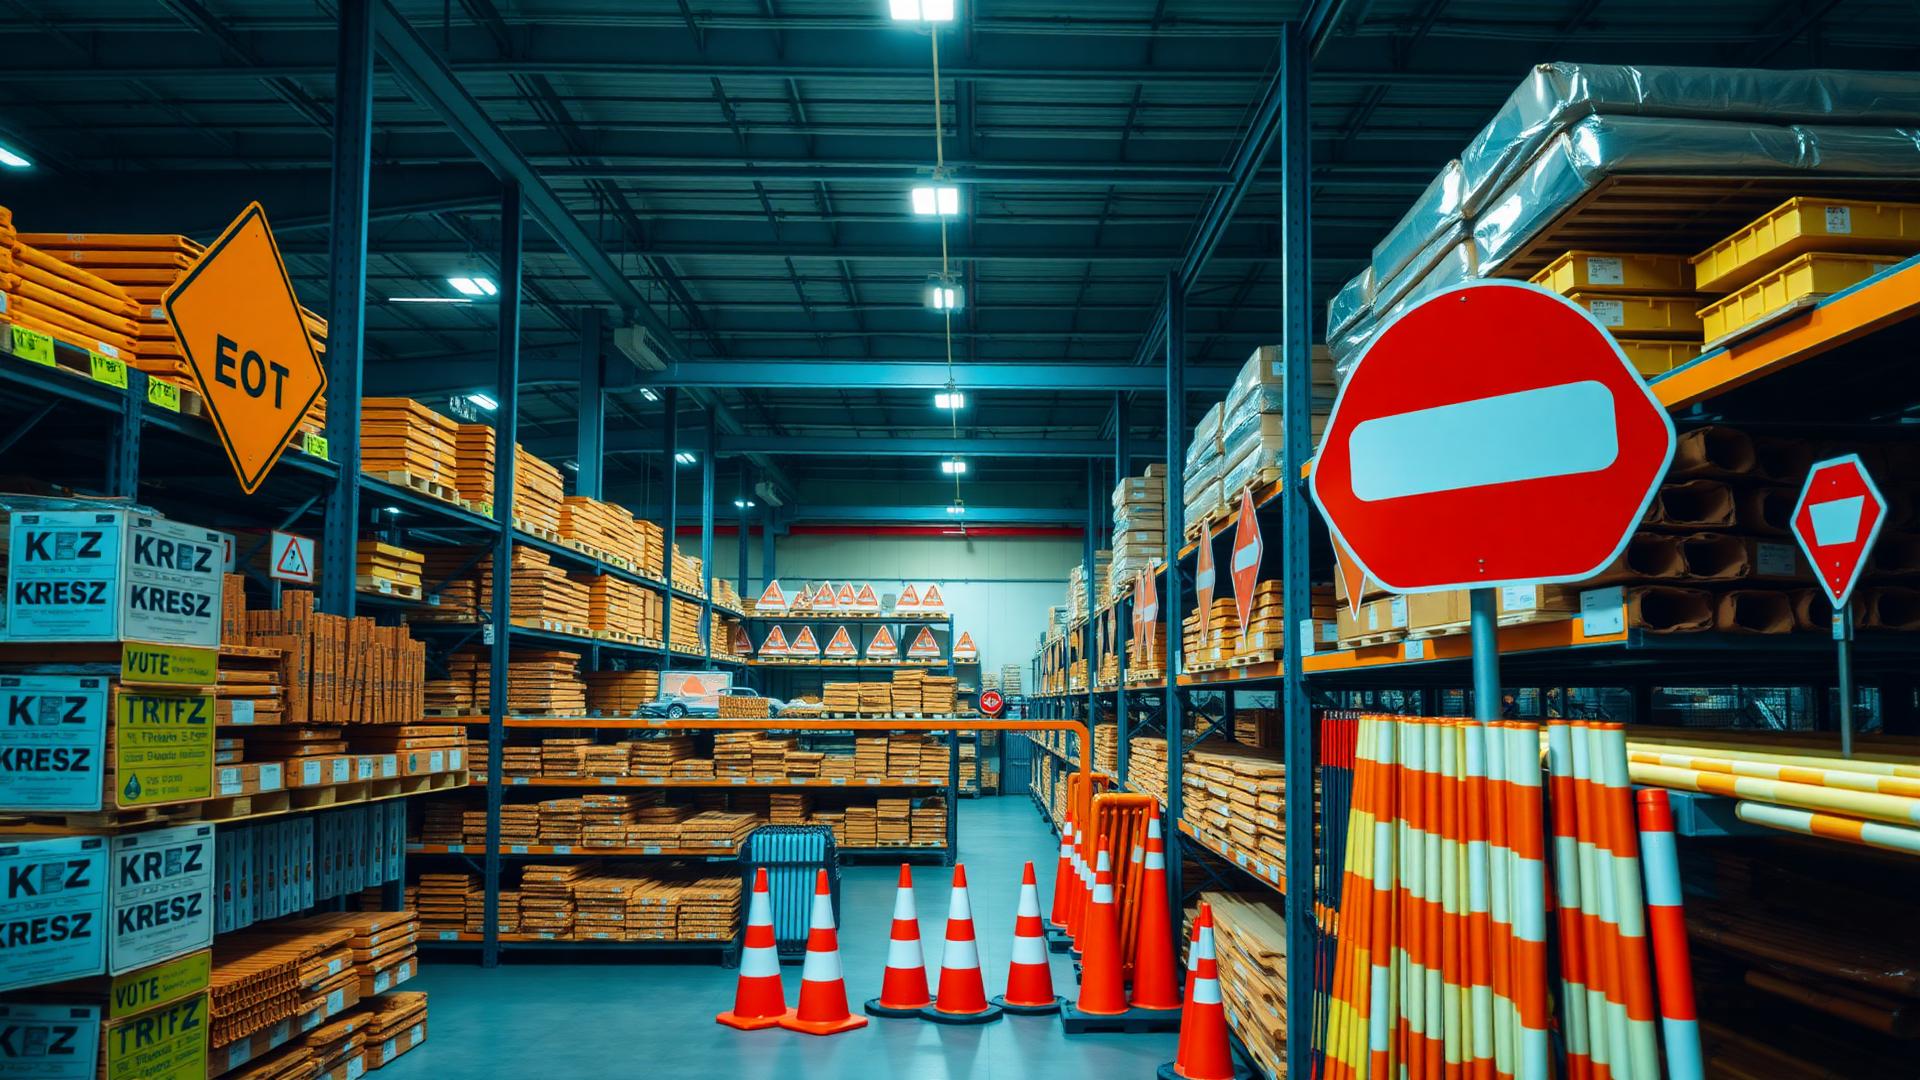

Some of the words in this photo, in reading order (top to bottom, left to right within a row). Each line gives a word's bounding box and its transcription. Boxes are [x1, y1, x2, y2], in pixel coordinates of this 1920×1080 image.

[214, 334, 290, 410] EOT
[15, 581, 107, 605] KRESZ
[130, 585, 212, 618] KRESZ
[117, 892, 202, 936] KRESZ
